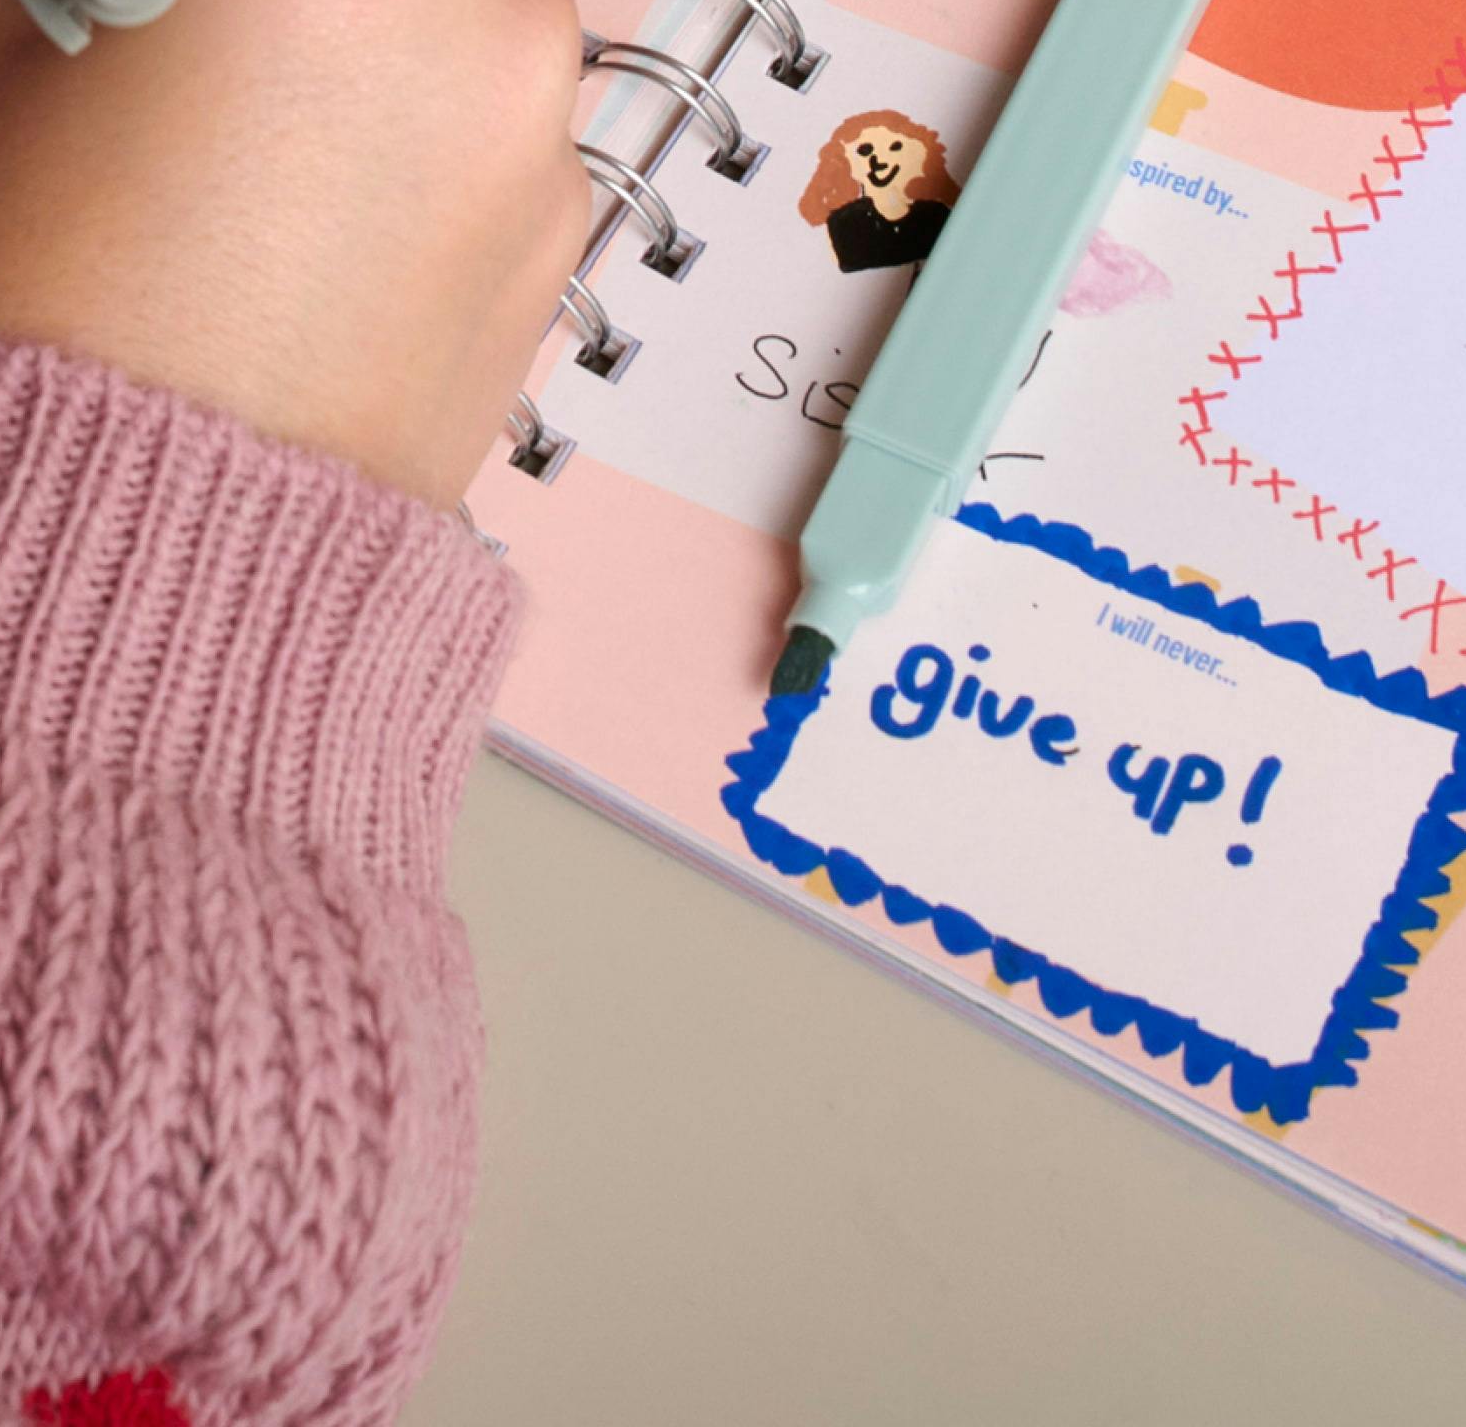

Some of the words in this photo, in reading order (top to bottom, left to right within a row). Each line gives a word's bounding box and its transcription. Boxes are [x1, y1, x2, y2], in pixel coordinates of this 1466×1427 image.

[1204, 180, 1250, 219] by...
[1096, 602, 1111, 626] I
[1110, 613, 1156, 646] will
[1153, 632, 1238, 687] never...
[869, 643, 1080, 765] give
[1108, 742, 1283, 869] up!
